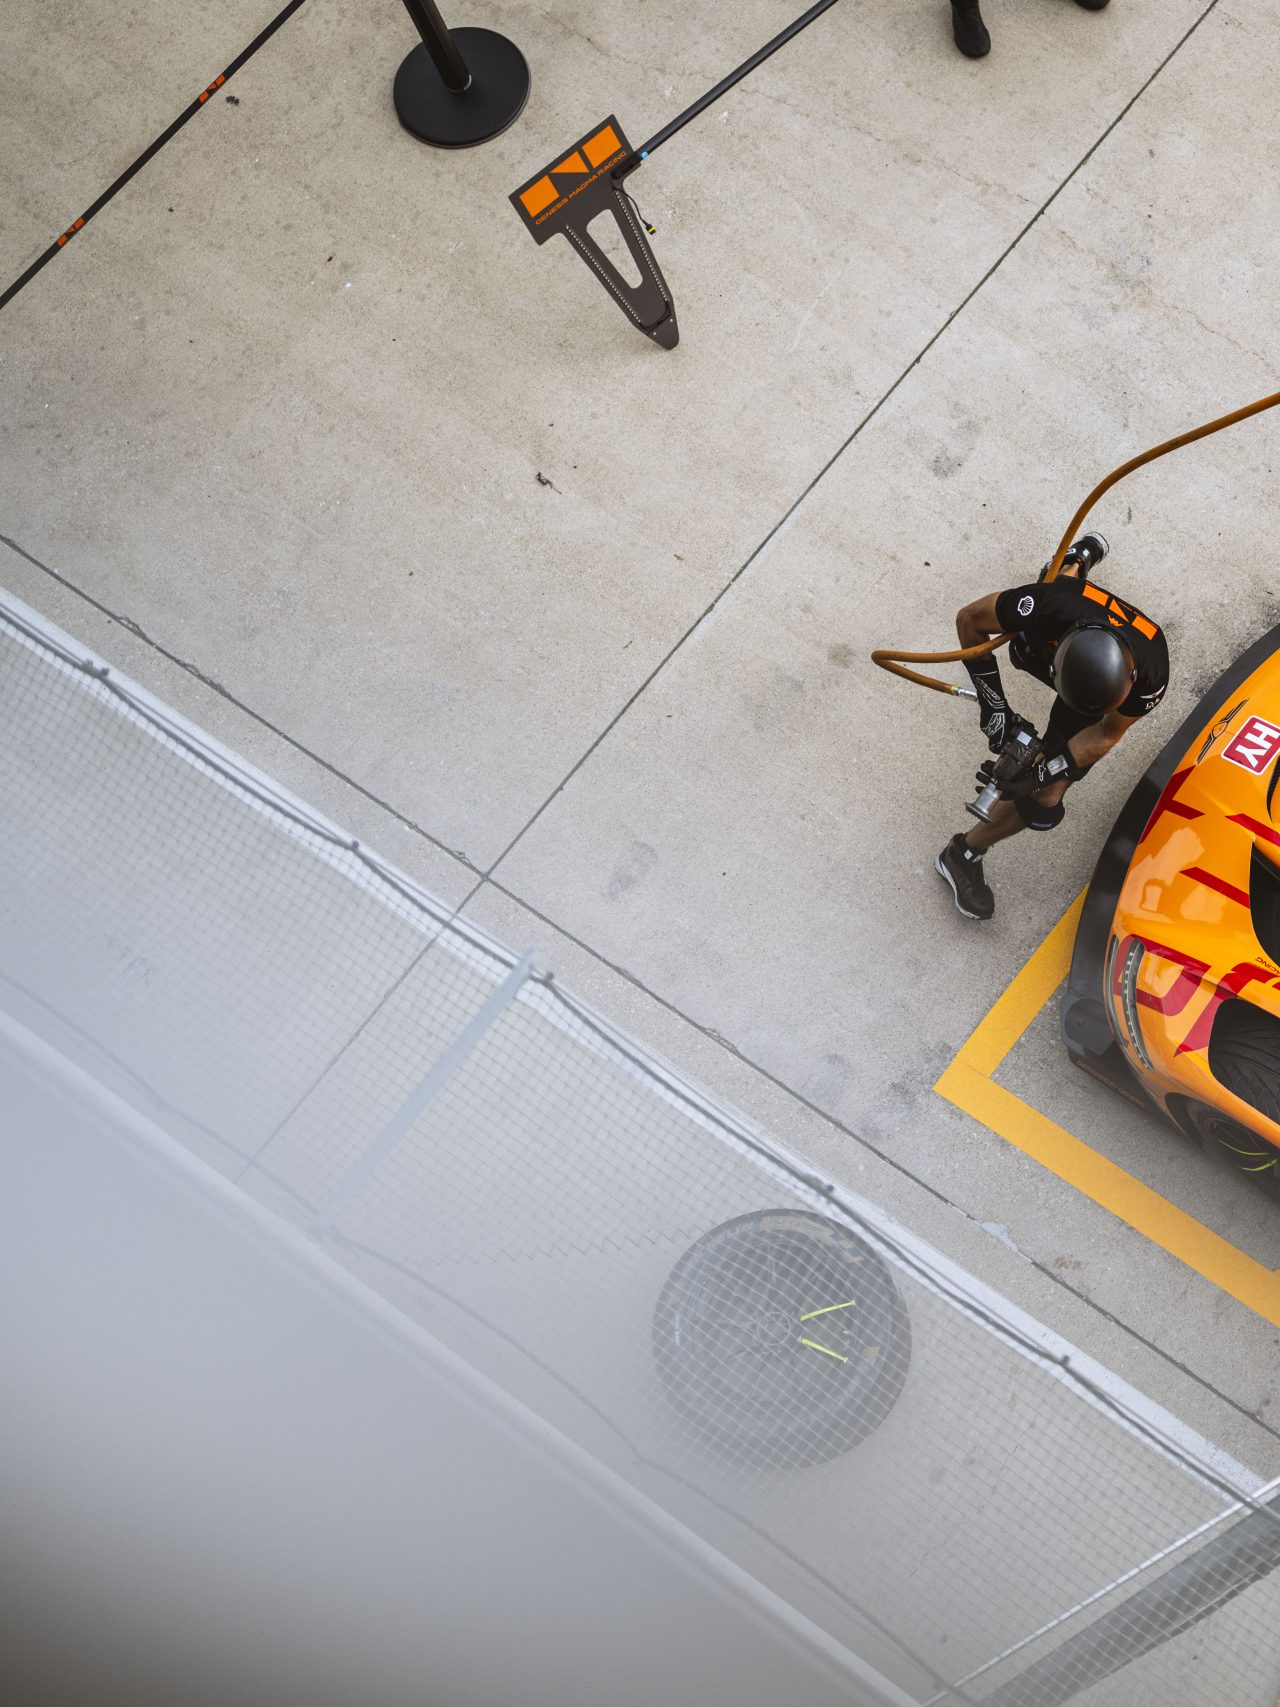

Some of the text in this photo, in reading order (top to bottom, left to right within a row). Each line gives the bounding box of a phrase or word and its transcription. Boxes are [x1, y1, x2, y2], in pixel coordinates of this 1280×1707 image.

[535, 151, 627, 225] GENESIS MAGMA RACING
[1235, 722, 1280, 768] HY
